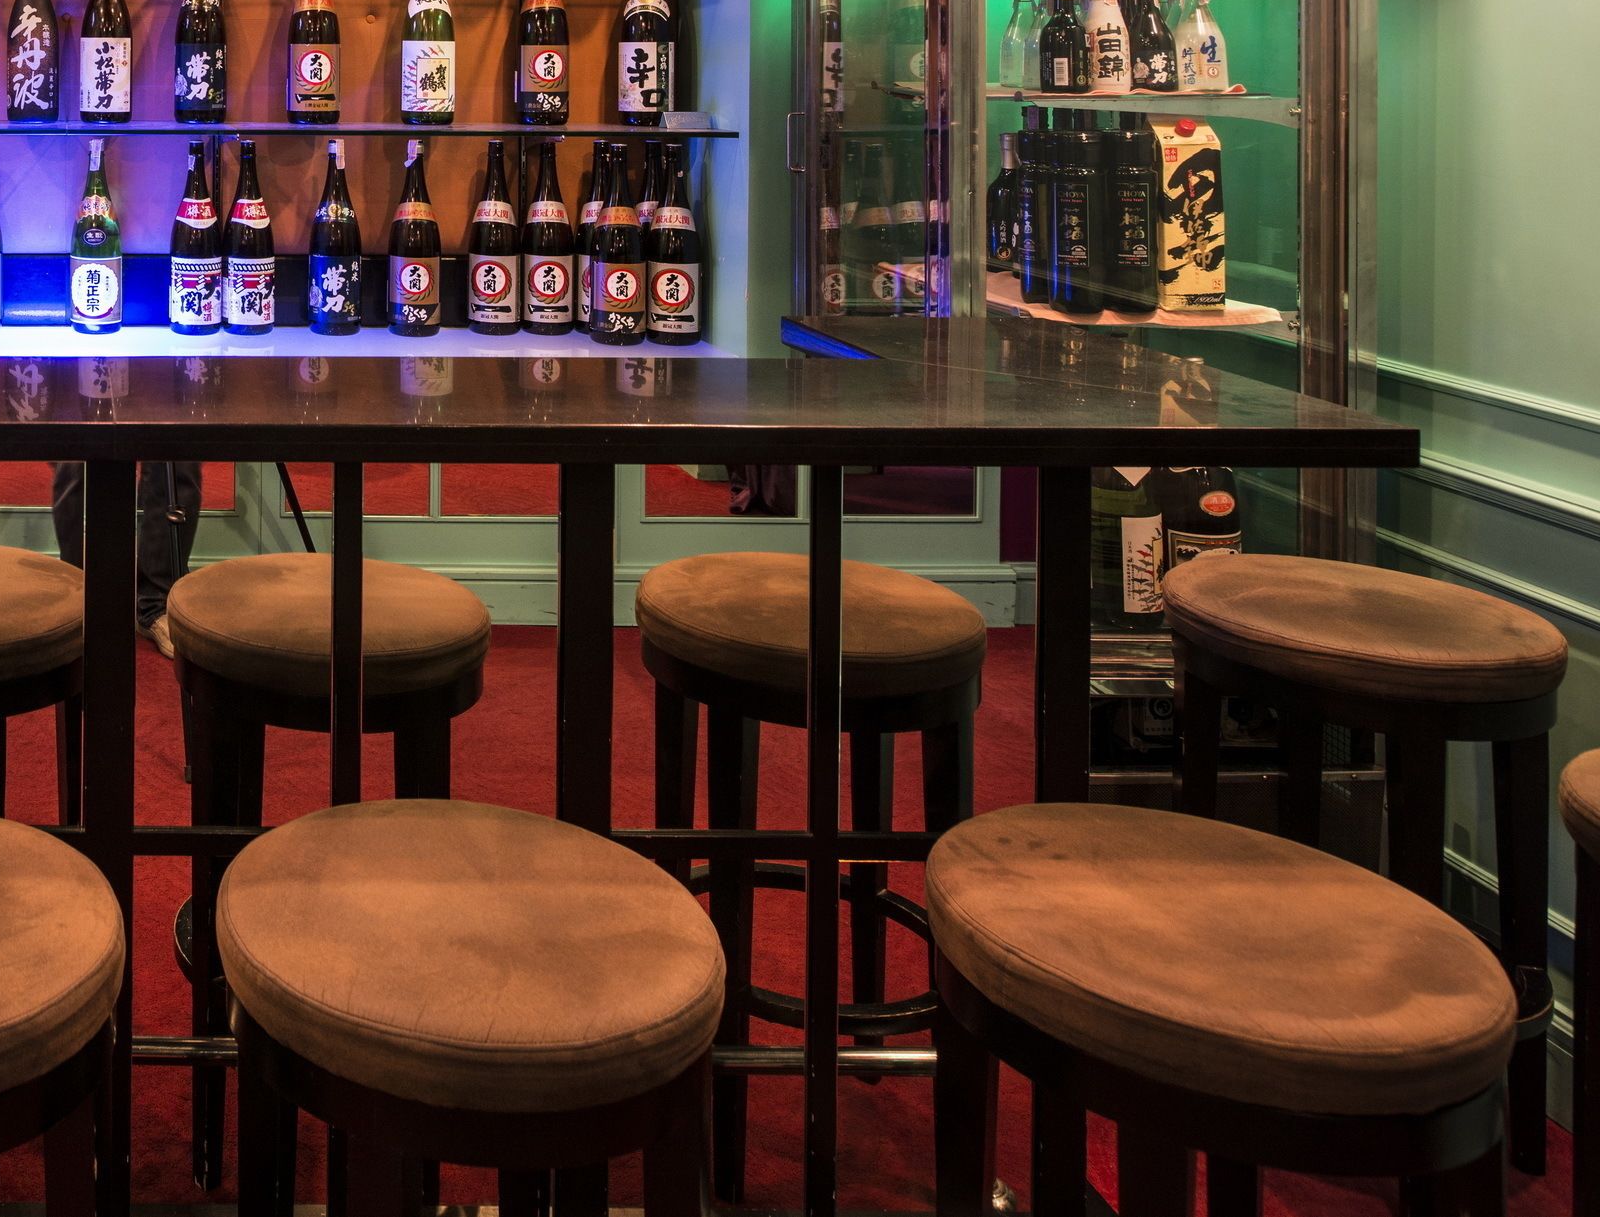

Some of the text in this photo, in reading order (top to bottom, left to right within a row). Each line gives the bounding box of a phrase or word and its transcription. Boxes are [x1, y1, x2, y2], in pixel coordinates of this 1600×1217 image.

[1097, 22, 1124, 82] 山田錦
[1200, 35, 1221, 63] 生
[95, 41, 116, 110] 小松帯刀
[186, 52, 212, 101] 帯刀
[310, 54, 323, 81] 大関
[543, 53, 556, 79] 大関
[1149, 52, 1168, 84] 帯刀
[1118, 190, 1146, 198] CHOYA
[86, 270, 101, 313] 菊正宗
[321, 264, 347, 313] 帯刀
[409, 266, 421, 291] 大関
[483, 265, 496, 292] 大関
[542, 265, 556, 292] 大関
[616, 272, 629, 298] 大関
[665, 273, 680, 301] 大関
